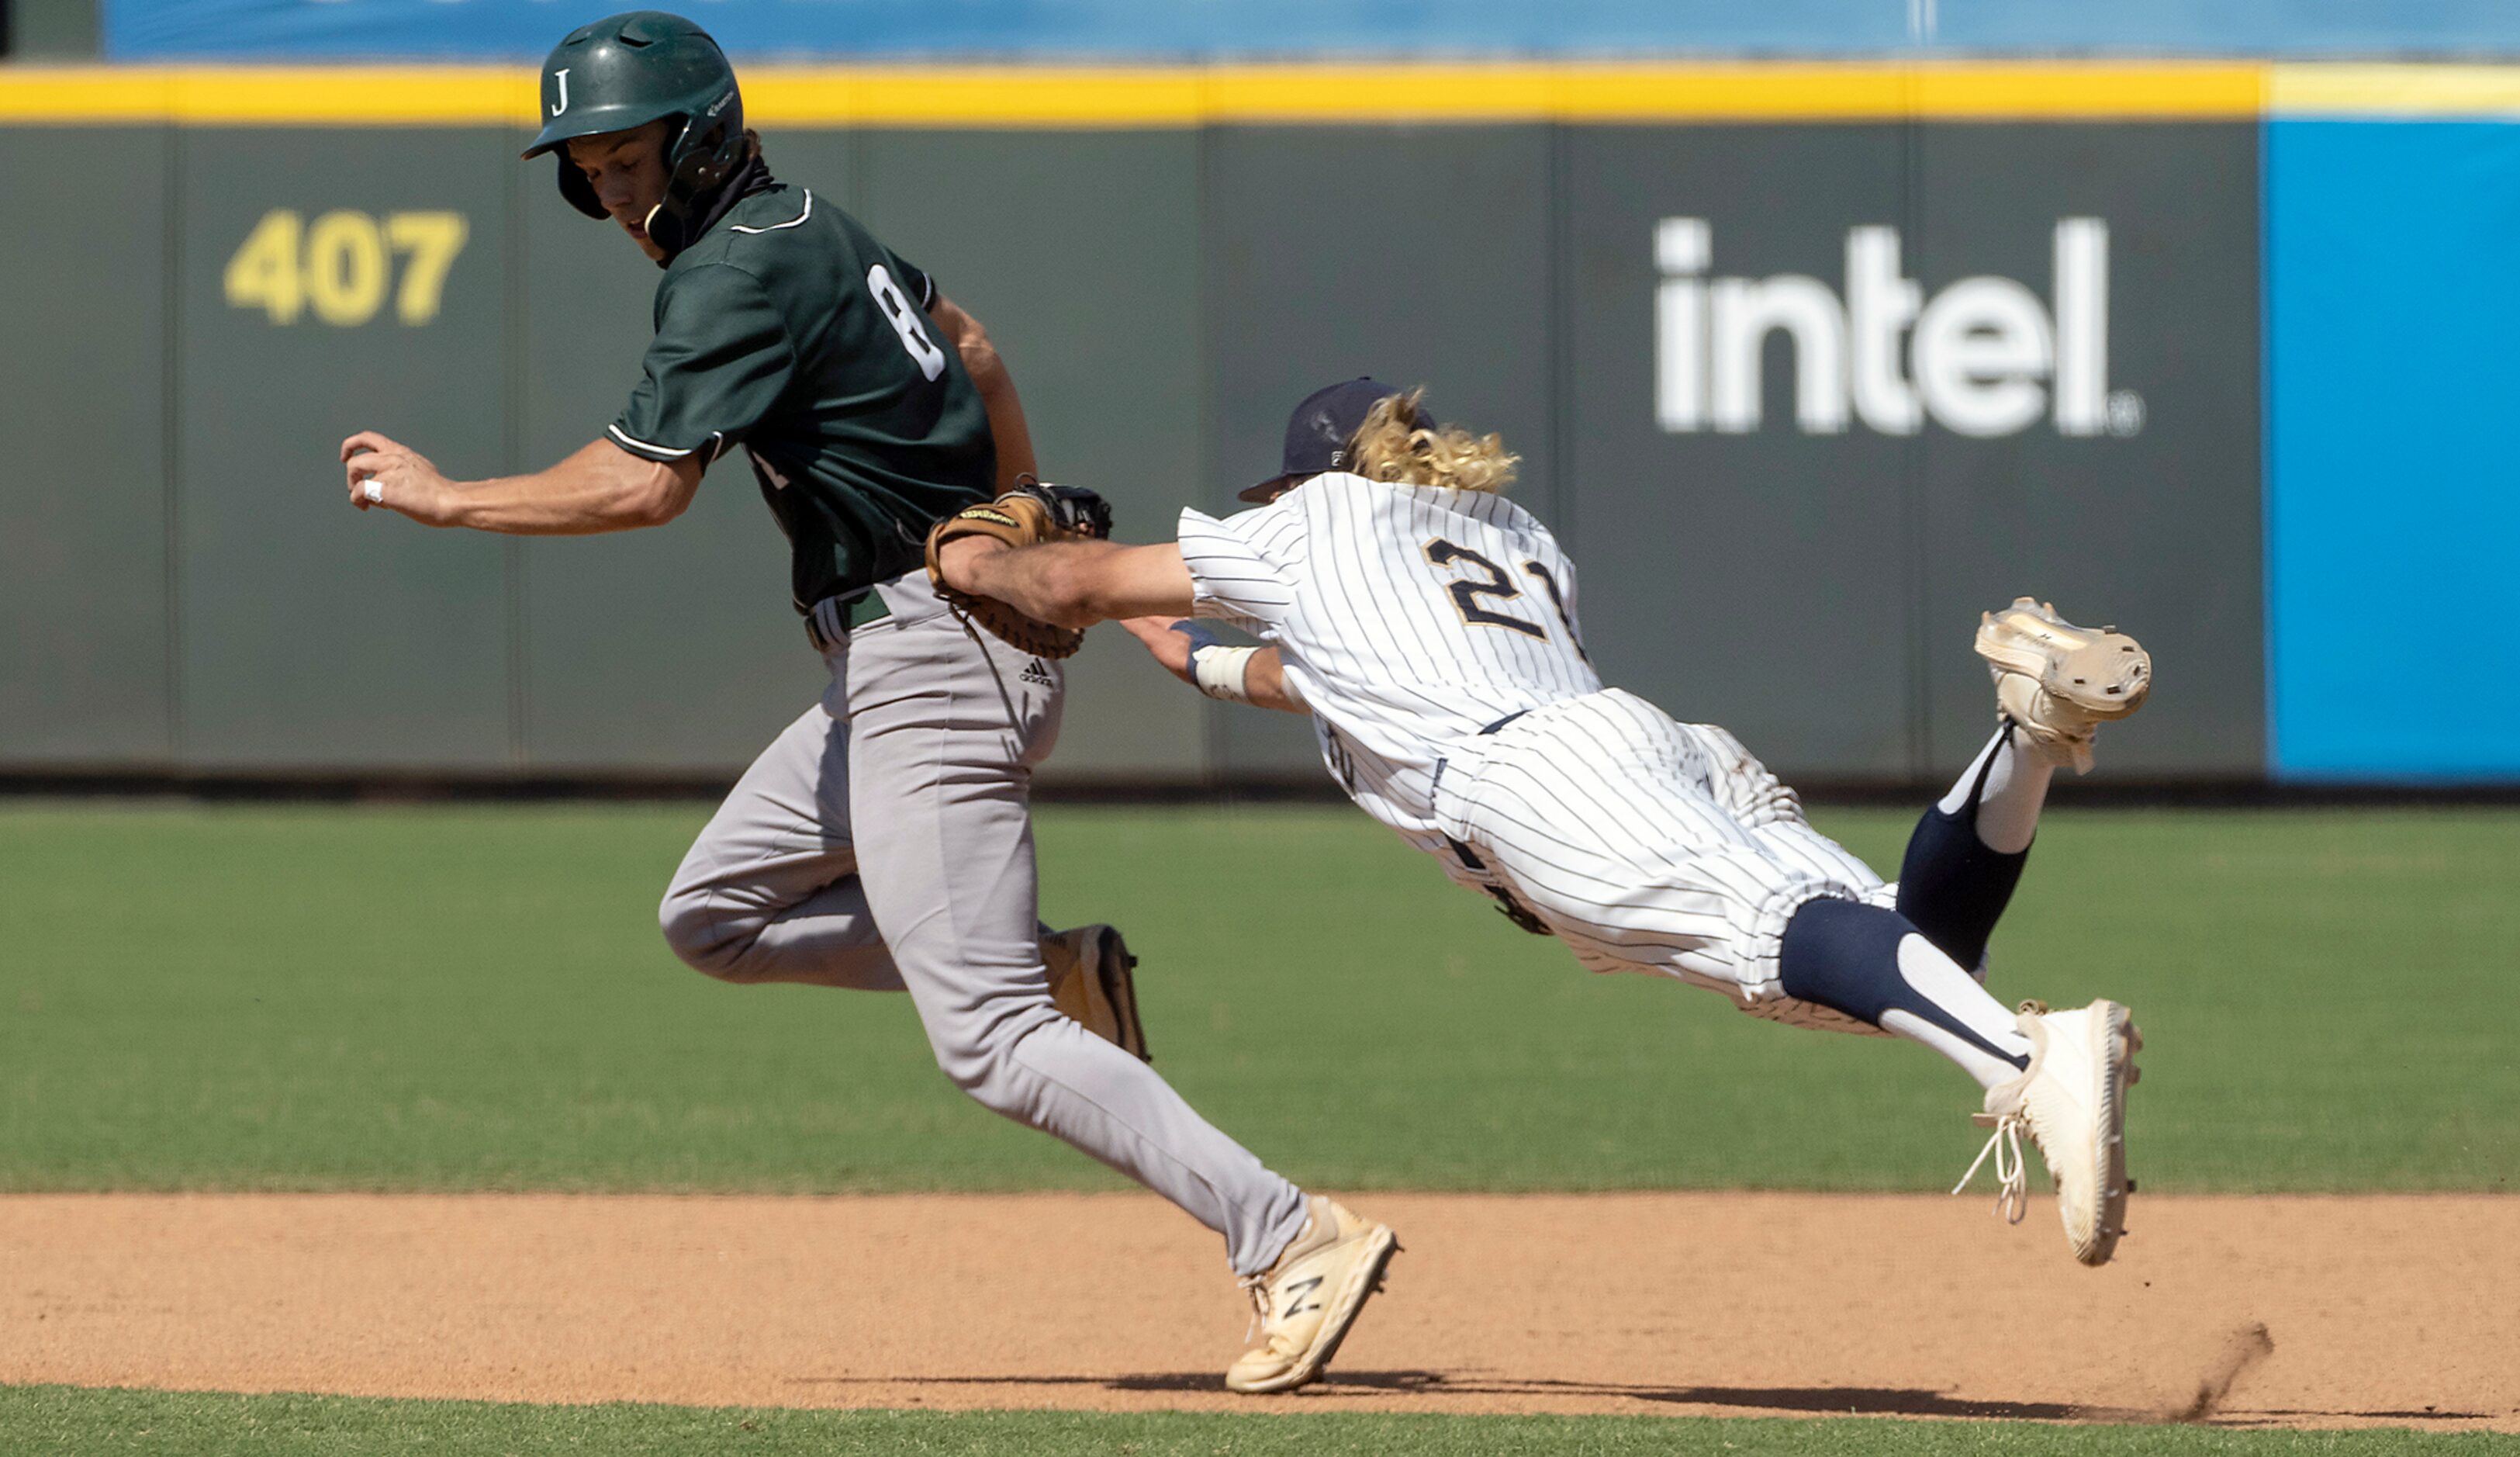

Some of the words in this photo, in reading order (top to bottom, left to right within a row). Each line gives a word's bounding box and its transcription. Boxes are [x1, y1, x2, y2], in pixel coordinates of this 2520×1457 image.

[551, 68, 569, 116] J
[224, 208, 468, 327] 407
[867, 264, 946, 382] 8
[1654, 216, 2109, 437] intel
[1421, 536, 1595, 670] 21
